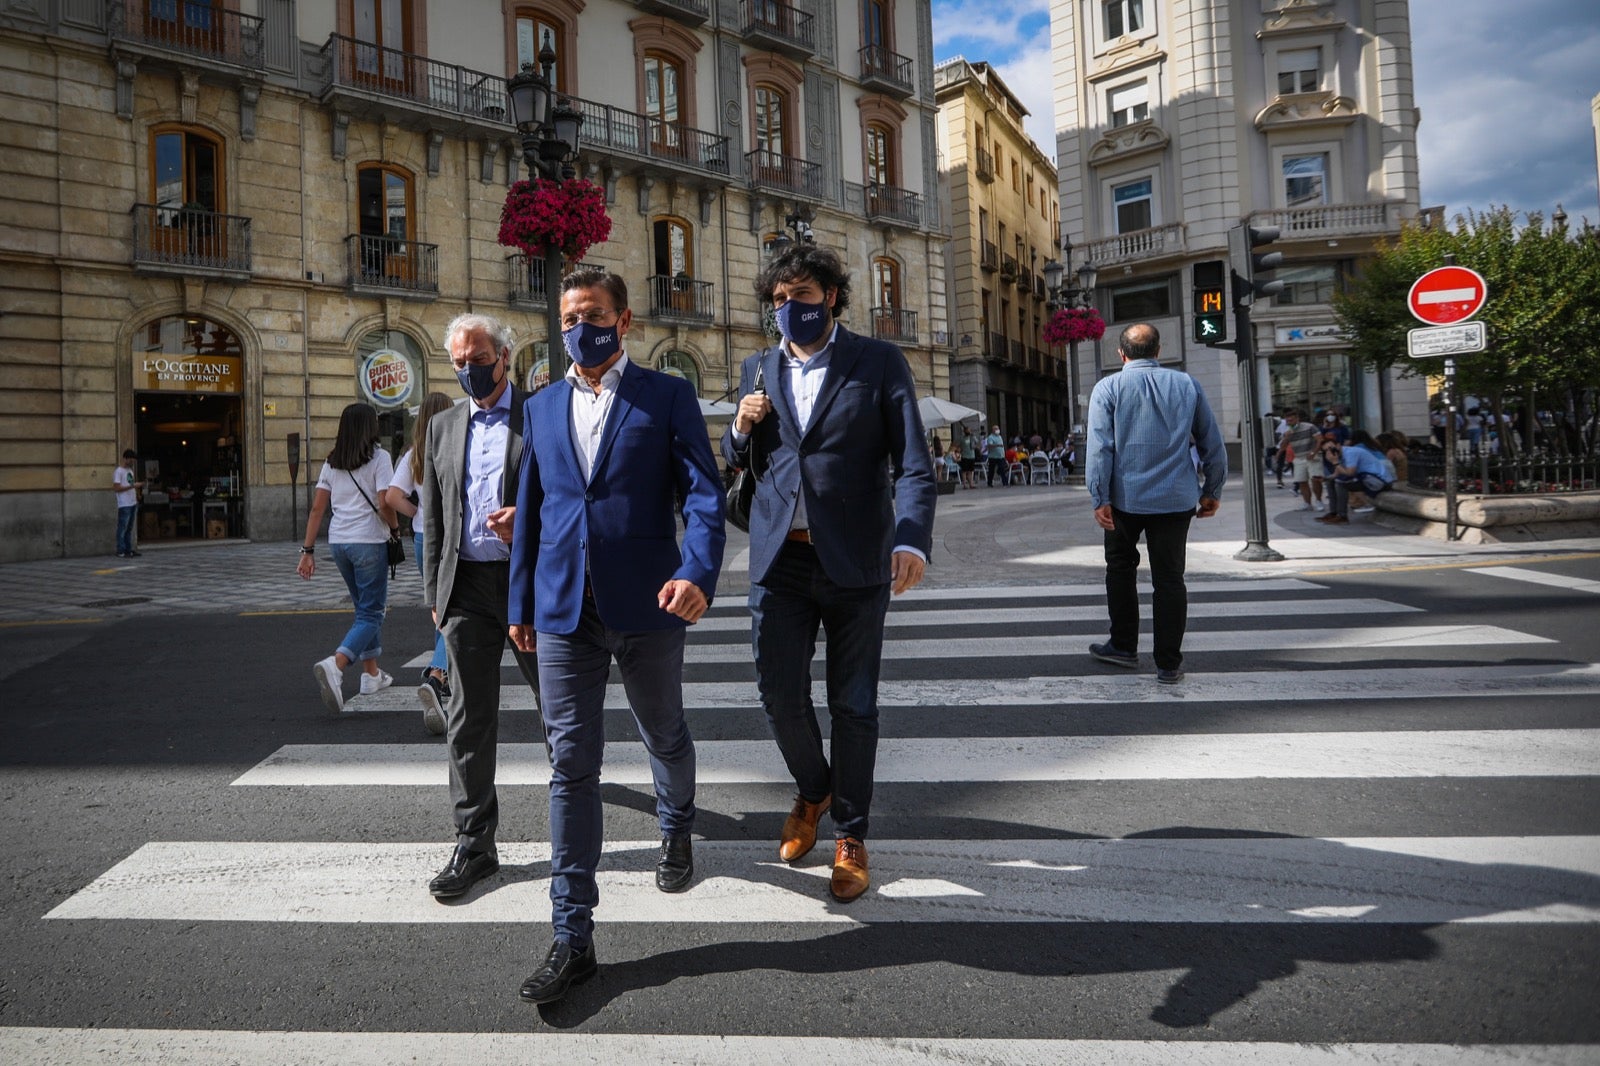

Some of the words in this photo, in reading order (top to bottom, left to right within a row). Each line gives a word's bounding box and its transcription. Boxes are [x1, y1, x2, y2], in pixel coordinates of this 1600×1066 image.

[1203, 291, 1221, 312] 14
[801, 311, 819, 322] GRX
[595, 334, 611, 345] GRX
[143, 359, 230, 375] L'OCCITANE
[369, 360, 406, 379] BURGER
[158, 372, 169, 380] EN
[174, 373, 220, 383] PROVENCE
[371, 370, 408, 392] KING
[534, 371, 549, 384] BUR
